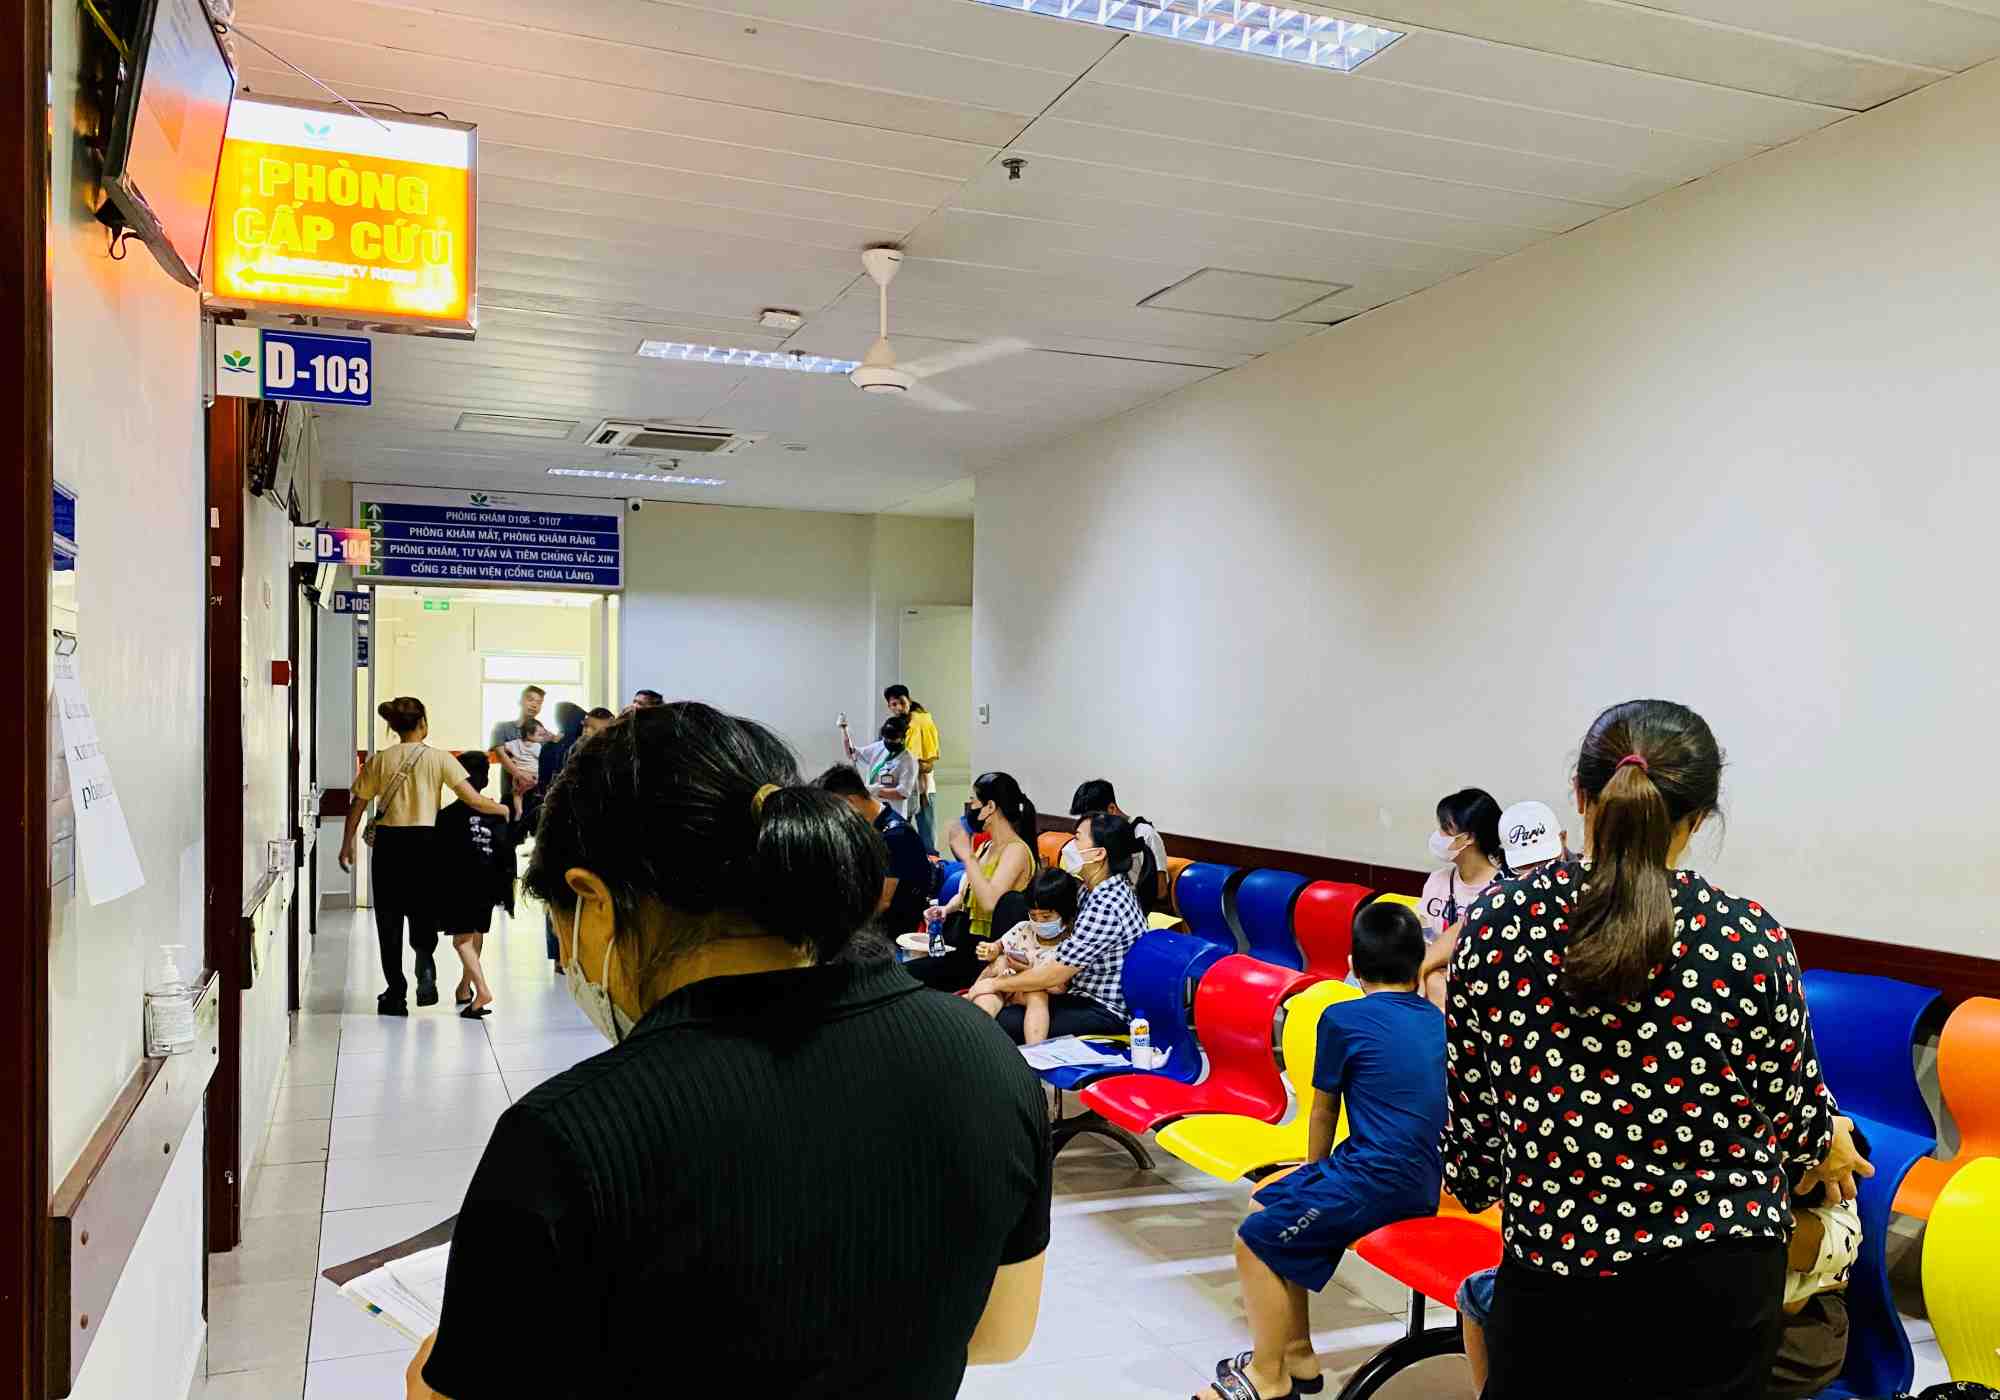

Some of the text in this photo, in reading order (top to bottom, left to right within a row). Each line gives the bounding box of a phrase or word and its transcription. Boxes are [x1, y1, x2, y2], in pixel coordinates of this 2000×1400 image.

[259, 158, 429, 216] PHÒNG
[233, 200, 453, 265] CẤP CỨU
[265, 341, 369, 396] D-103
[409, 525, 444, 538] PHÒNG
[503, 531, 536, 543] PHÒNG
[389, 543, 425, 555] PHÒNG
[477, 545, 497, 558] VẤN
[499, 549, 512, 560] VÀ
[597, 554, 614, 564] XIN
[441, 565, 449, 575] 2
[335, 594, 369, 611] D-105
[1509, 822, 1546, 844] Paris
